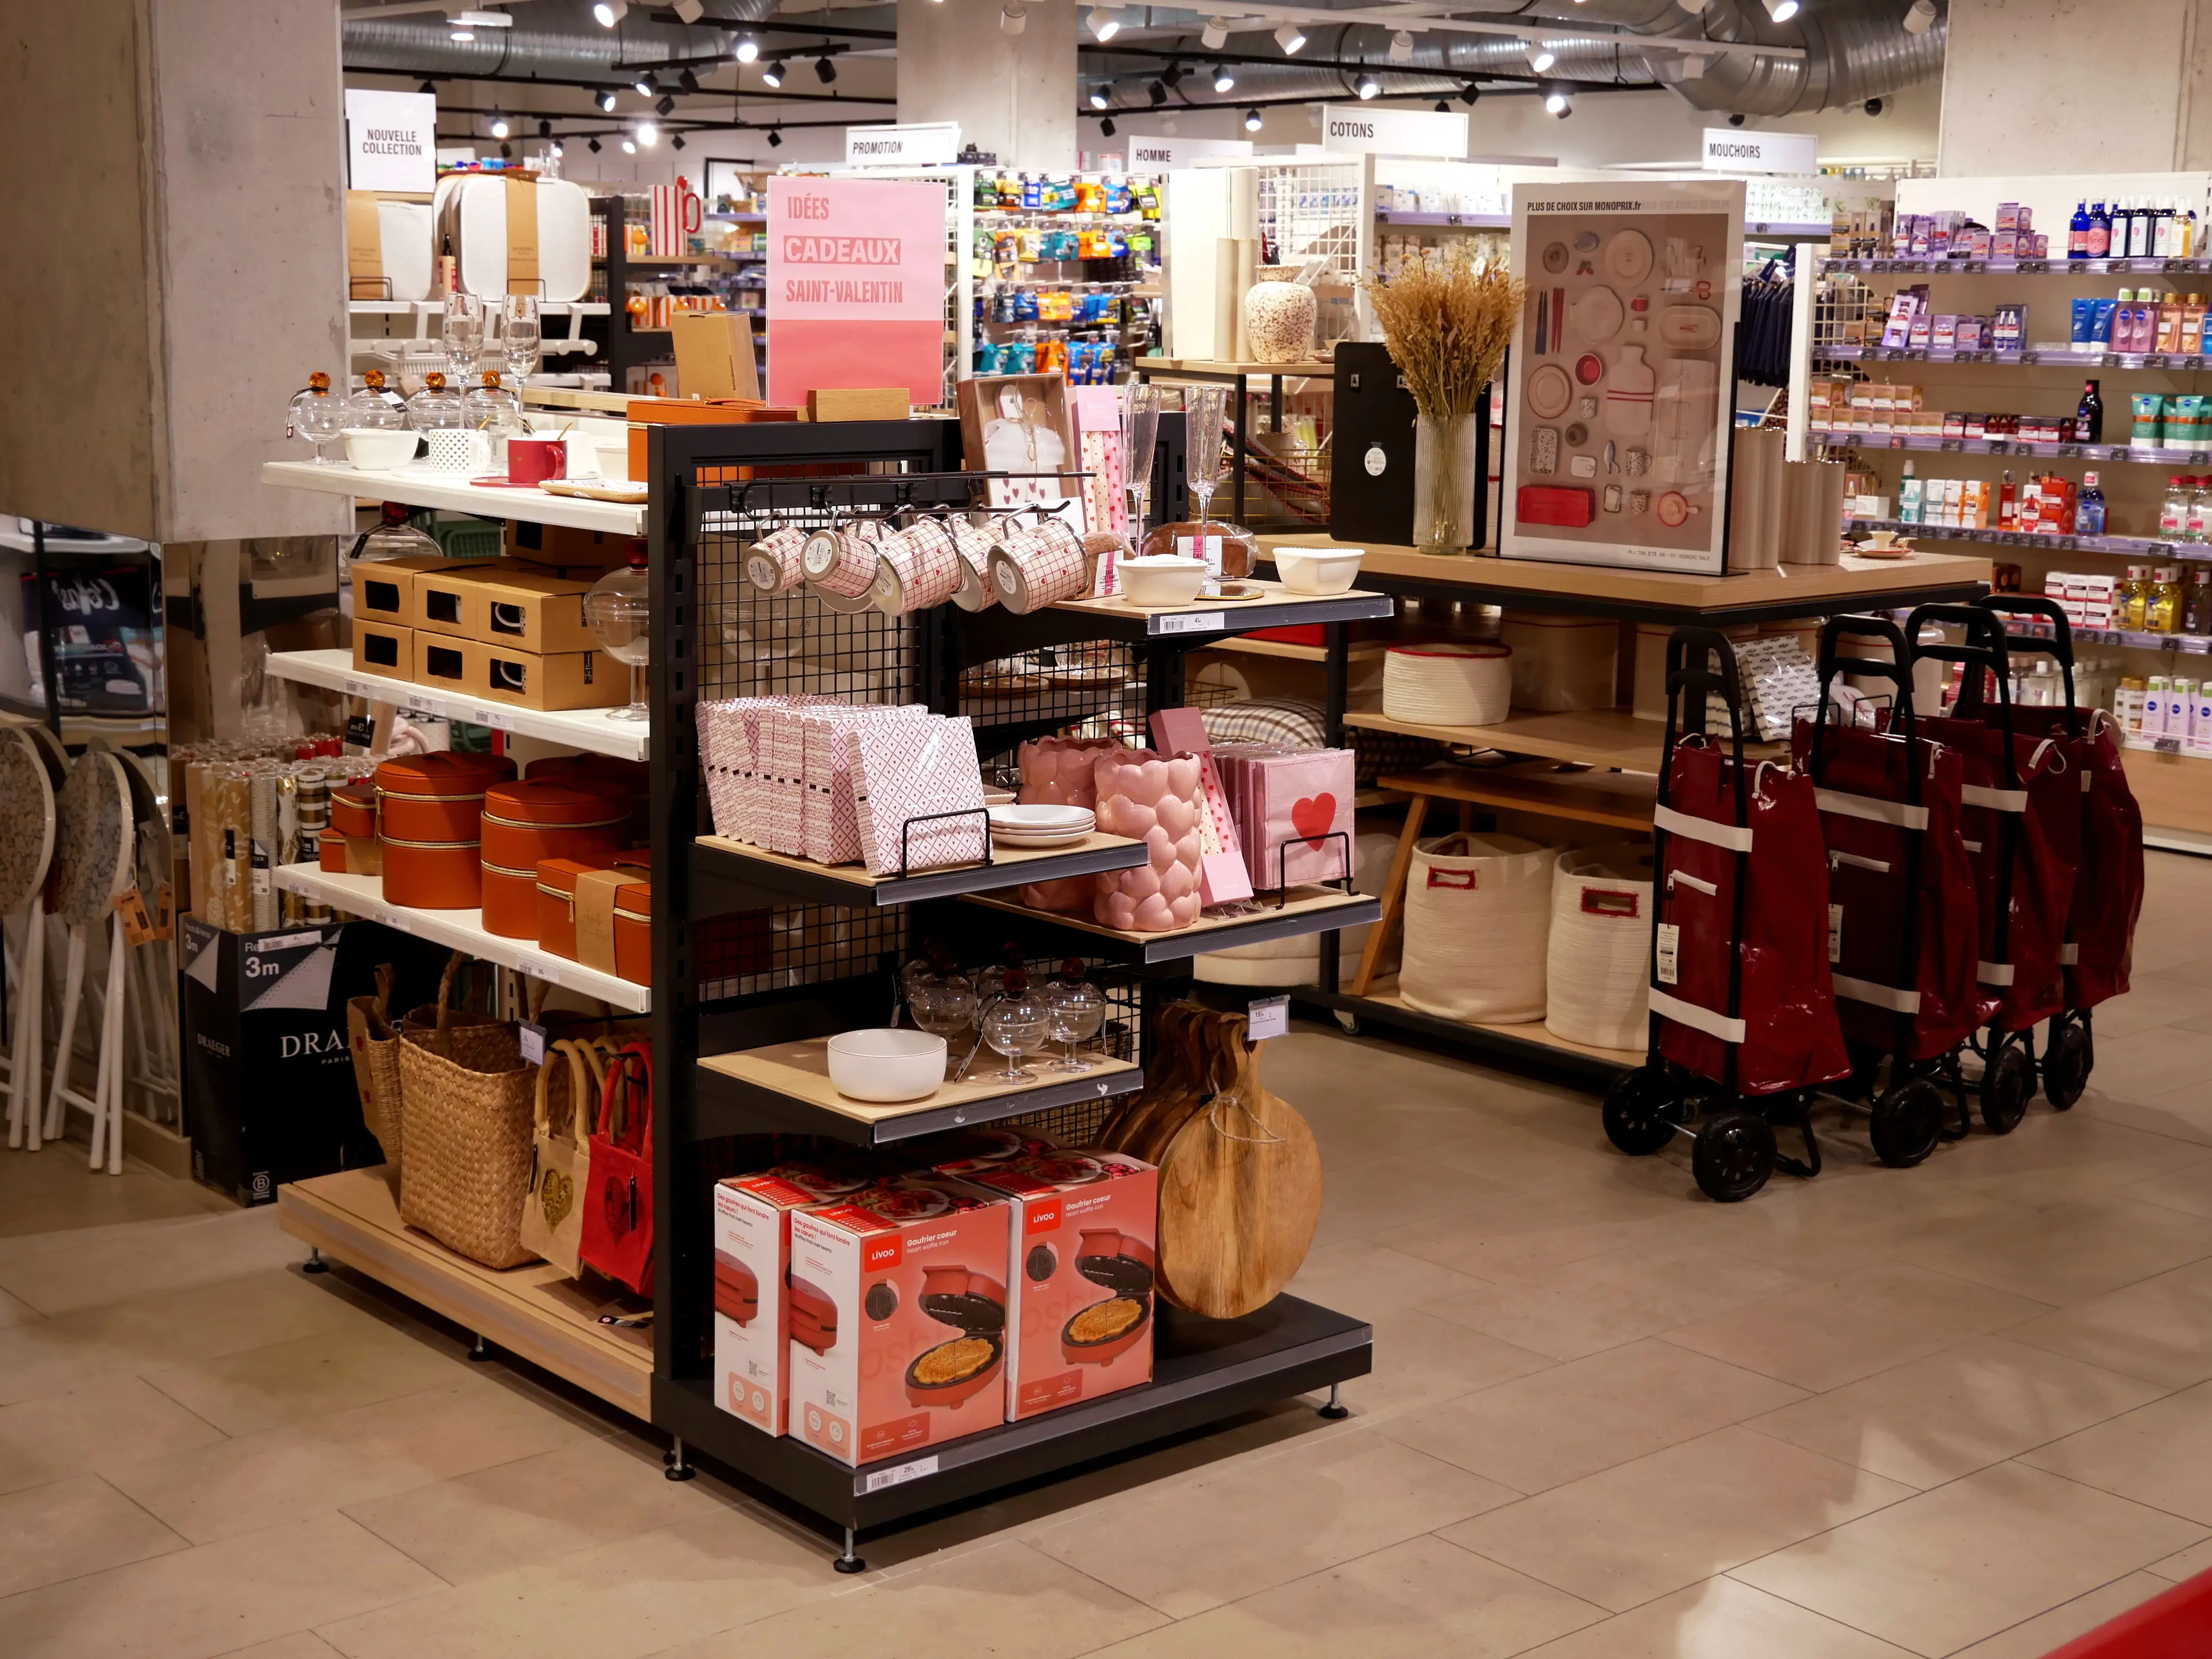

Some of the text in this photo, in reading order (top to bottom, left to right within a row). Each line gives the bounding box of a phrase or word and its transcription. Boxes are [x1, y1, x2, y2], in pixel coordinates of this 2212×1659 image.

[367, 129, 416, 142] NOUVELLE
[1330, 121, 1373, 138] COTONS
[363, 142, 422, 156] COLLECTION
[853, 140, 903, 155] PROMOTION
[1136, 148, 1172, 162] HOMME
[1709, 143, 1760, 159] MOUCHOIRS
[788, 193, 829, 220] IDÉES
[1527, 201, 1641, 211] PLUS DE CHOIX SUR MONOPRIX.fr
[785, 238, 900, 264] CADEAUX
[786, 279, 903, 304] SAINT-VALENTIN
[245, 957, 280, 978] 3m
[197, 1033, 230, 1057] DRAEGER
[321, 1056, 350, 1065] PARIS
[725, 1196, 740, 1207] gaufres
[756, 1208, 769, 1220] fondre
[1066, 1195, 1111, 1210] Gaufrier coeur
[1080, 1206, 1093, 1214] waffle
[794, 1218, 802, 1226] Des
[802, 1221, 819, 1233] gaufres
[826, 1231, 835, 1239] font
[835, 1233, 850, 1246] fondre
[907, 1230, 957, 1247] Gaufrier coeur
[922, 1242, 938, 1251] waffle
